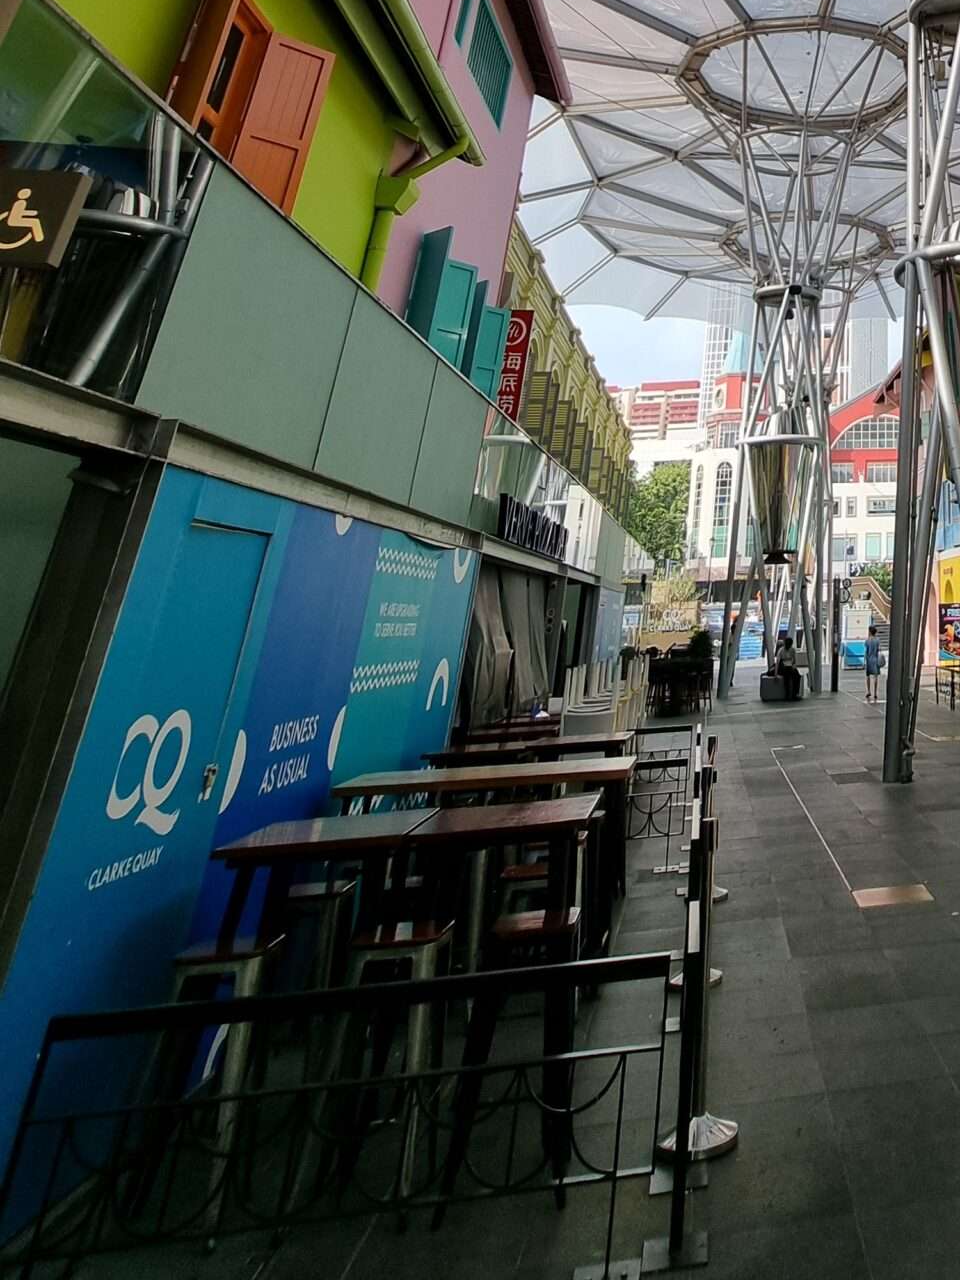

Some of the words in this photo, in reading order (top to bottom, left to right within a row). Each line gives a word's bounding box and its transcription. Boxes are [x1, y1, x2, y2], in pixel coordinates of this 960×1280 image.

[269, 714, 320, 752] BUSINESS
[106, 709, 192, 836] CQ
[257, 763, 278, 796] AS
[277, 753, 311, 789] USUAL
[88, 855, 132, 891] CLARKE
[131, 845, 165, 874] QUAY
